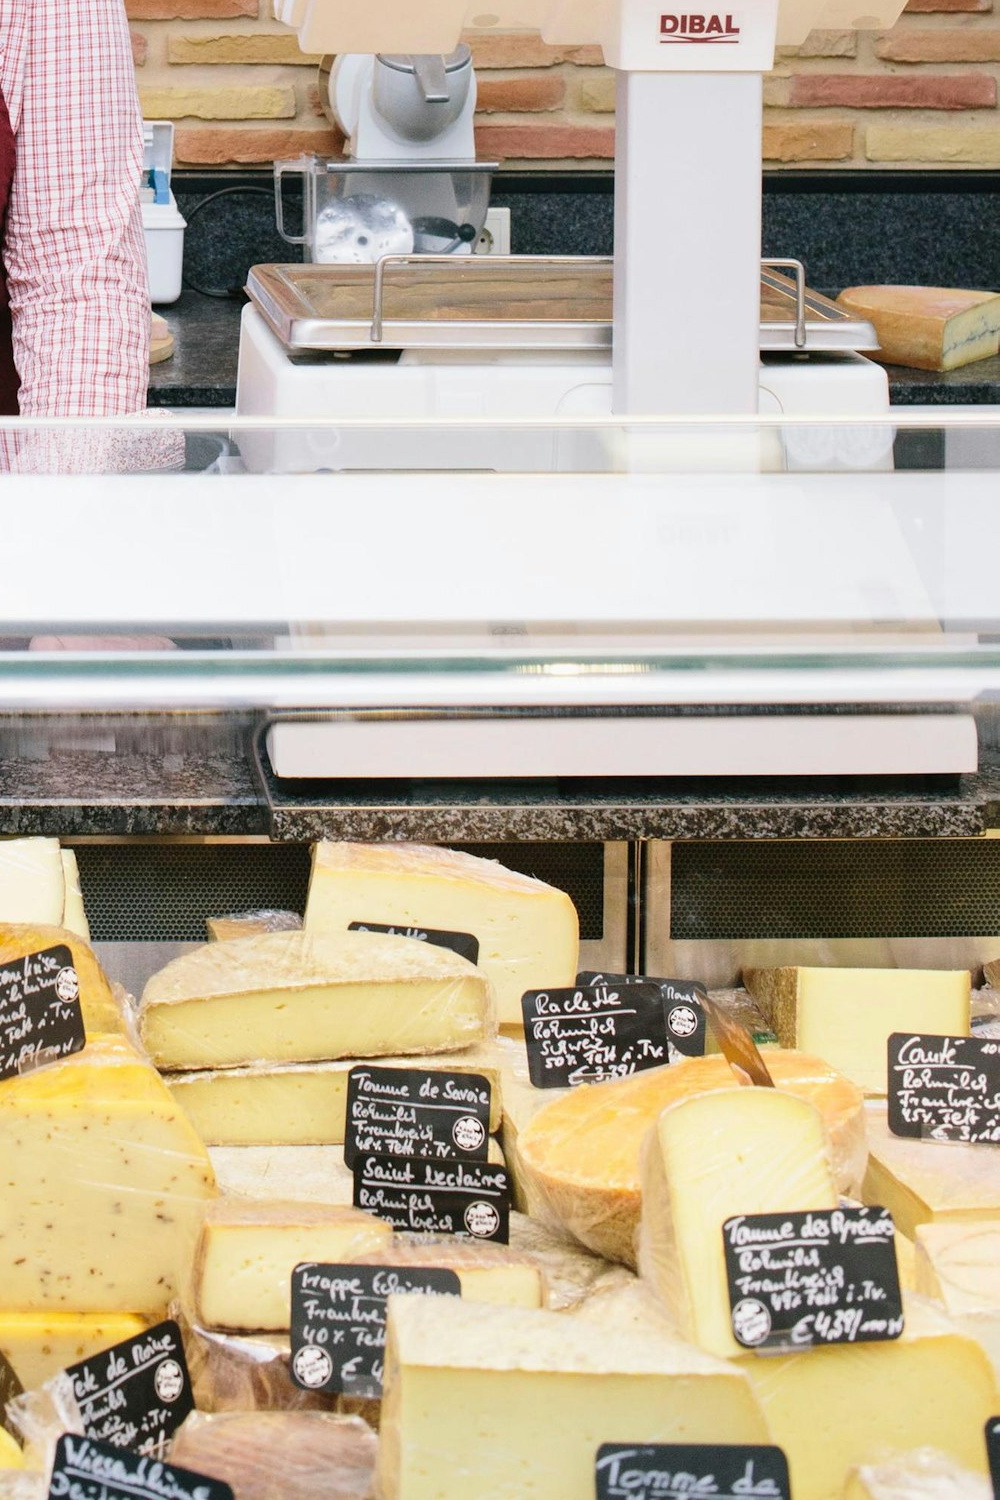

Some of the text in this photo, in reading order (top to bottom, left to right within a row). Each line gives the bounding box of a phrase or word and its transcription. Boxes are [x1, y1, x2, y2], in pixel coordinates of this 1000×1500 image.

[660, 14, 740, 35] DIBAL
[535, 986, 622, 1015] Raclette
[5, 1016, 33, 1045] Fett
[533, 1017, 616, 1040] Rohmilch
[540, 1036, 605, 1056] Schweiz
[583, 1045, 616, 1067] Fett
[898, 1036, 966, 1065] Comté
[351, 1072, 489, 1104] Tomme de Savoie
[902, 1068, 987, 1094] Rohmilch
[352, 1101, 417, 1124] Rohmilch
[938, 1107, 981, 1126] Fett
[352, 1118, 434, 1142] Frankreich
[385, 1137, 415, 1155] Fett
[362, 1156, 508, 1190] Saint Nectaire
[359, 1187, 435, 1212] Rohmilch
[724, 1215, 796, 1245] Tomme
[799, 1213, 830, 1239] des
[738, 1247, 820, 1273] Rohmilch
[295, 1263, 364, 1303] Trappe
[735, 1265, 845, 1296] Frankreich
[803, 1286, 840, 1307] Fett
[303, 1299, 390, 1325] Frankre
[106, 1334, 176, 1381] de Moine
[595, 1449, 719, 1494] Tomme
